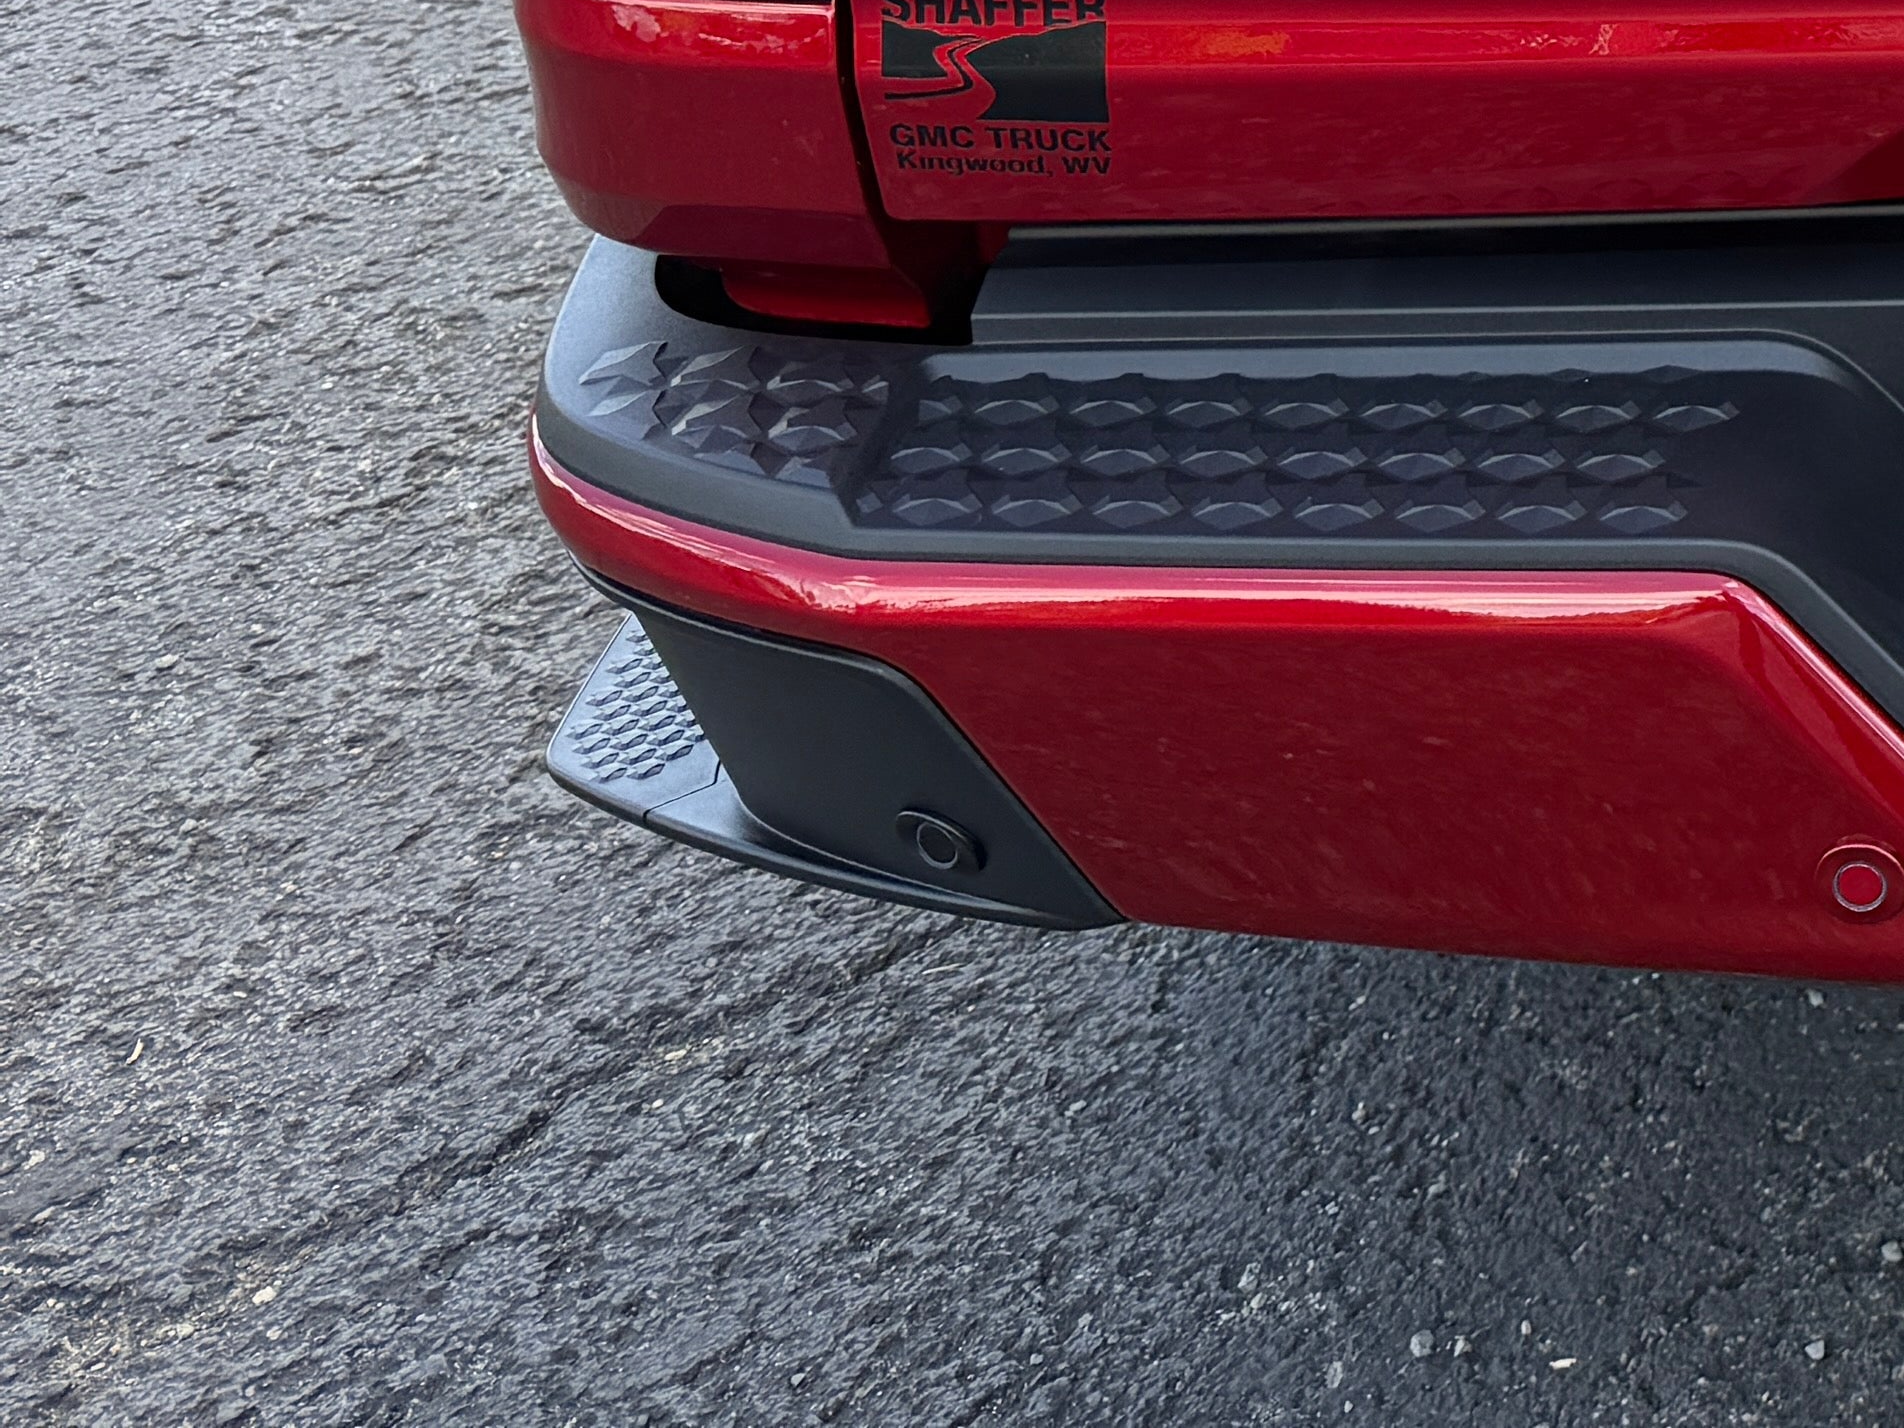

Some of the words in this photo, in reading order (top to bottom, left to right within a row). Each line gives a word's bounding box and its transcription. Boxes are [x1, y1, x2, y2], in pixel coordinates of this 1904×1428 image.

[890, 124, 974, 148] GMC
[986, 127, 1112, 152] TRUCK
[1062, 157, 1111, 175] WV
